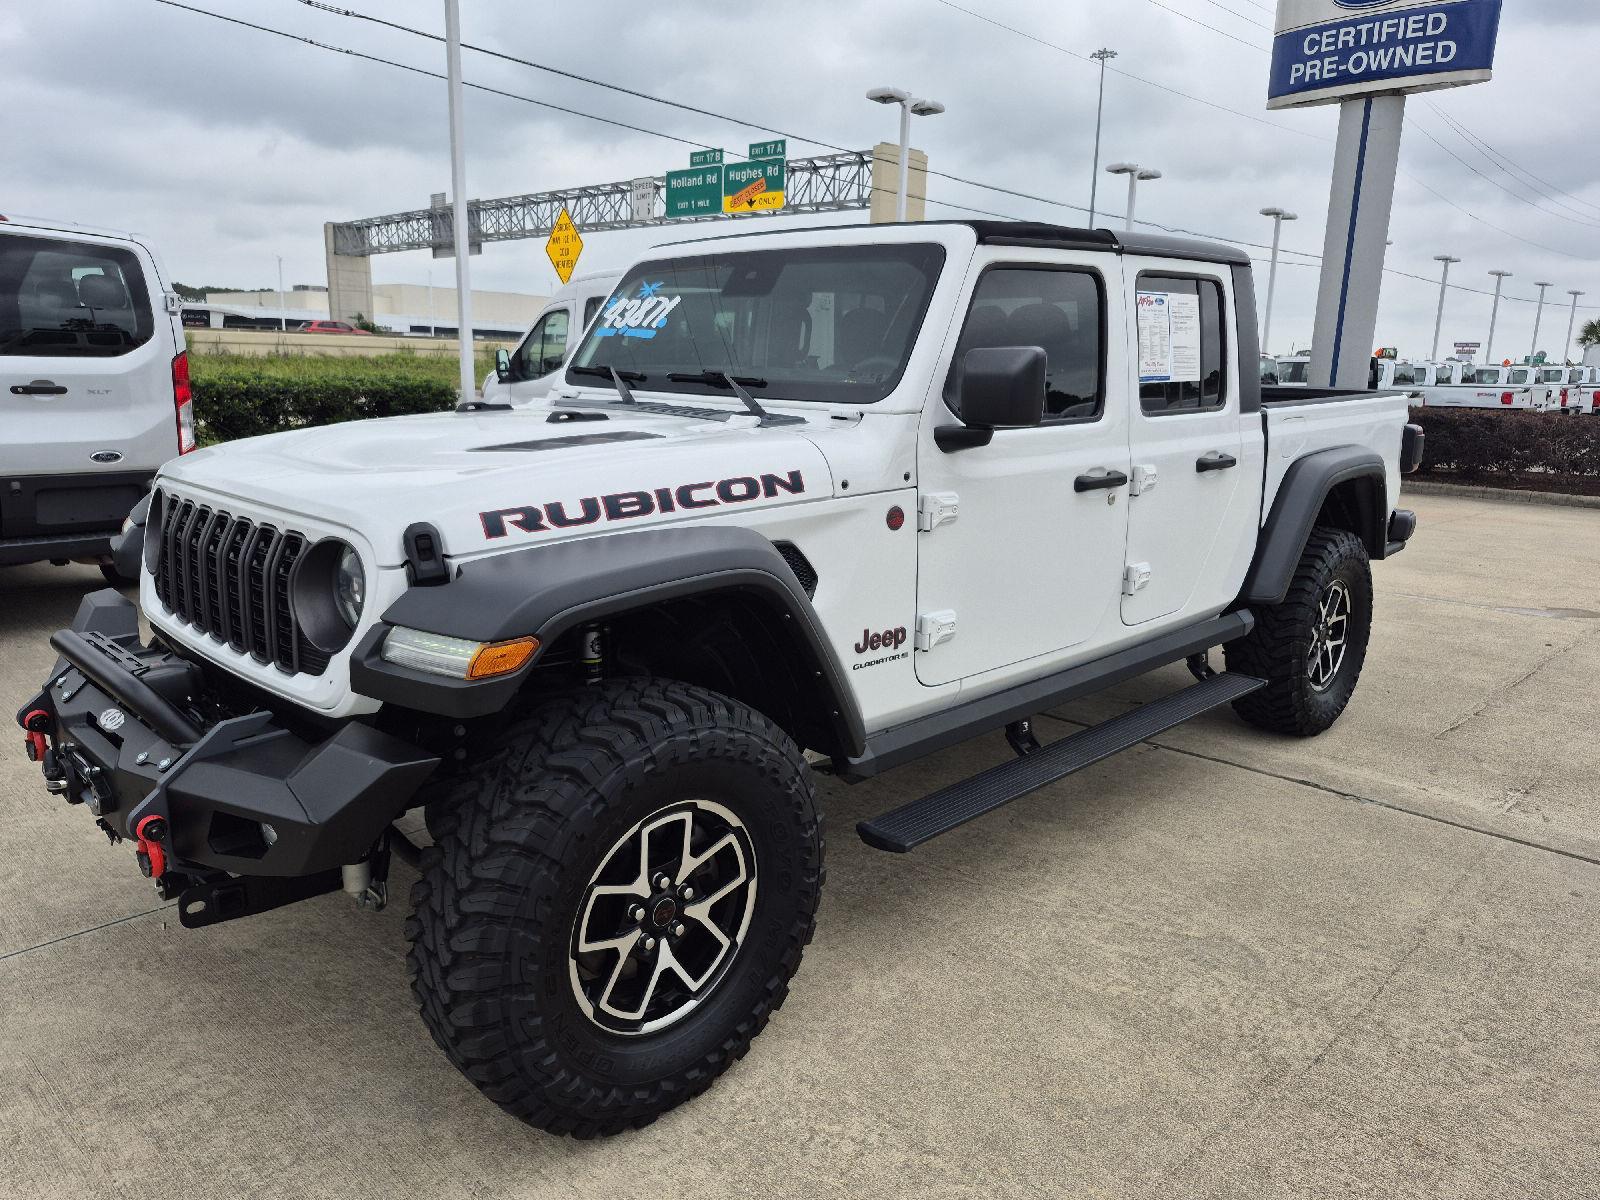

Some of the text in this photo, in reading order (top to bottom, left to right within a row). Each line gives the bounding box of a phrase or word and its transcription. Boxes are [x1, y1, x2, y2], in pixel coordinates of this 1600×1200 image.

[1303, 12, 1448, 56] CERTIFIED
[1289, 40, 1457, 85] PRE-OWNED
[692, 151, 721, 163] EXIT 17 B
[751, 143, 783, 155] EXIT 17 A
[671, 172, 718, 189] Holland Rd
[729, 165, 779, 182] Hughes Rd
[634, 182, 653, 191] SPEED
[636, 192, 651, 201] LIMIT
[677, 199, 710, 209] EXIT 1 MILE
[758, 196, 777, 205] ONLY
[478, 469, 807, 541] RUBICON
[854, 626, 907, 654] Jeep
[852, 654, 901, 671] GLADIATOR
